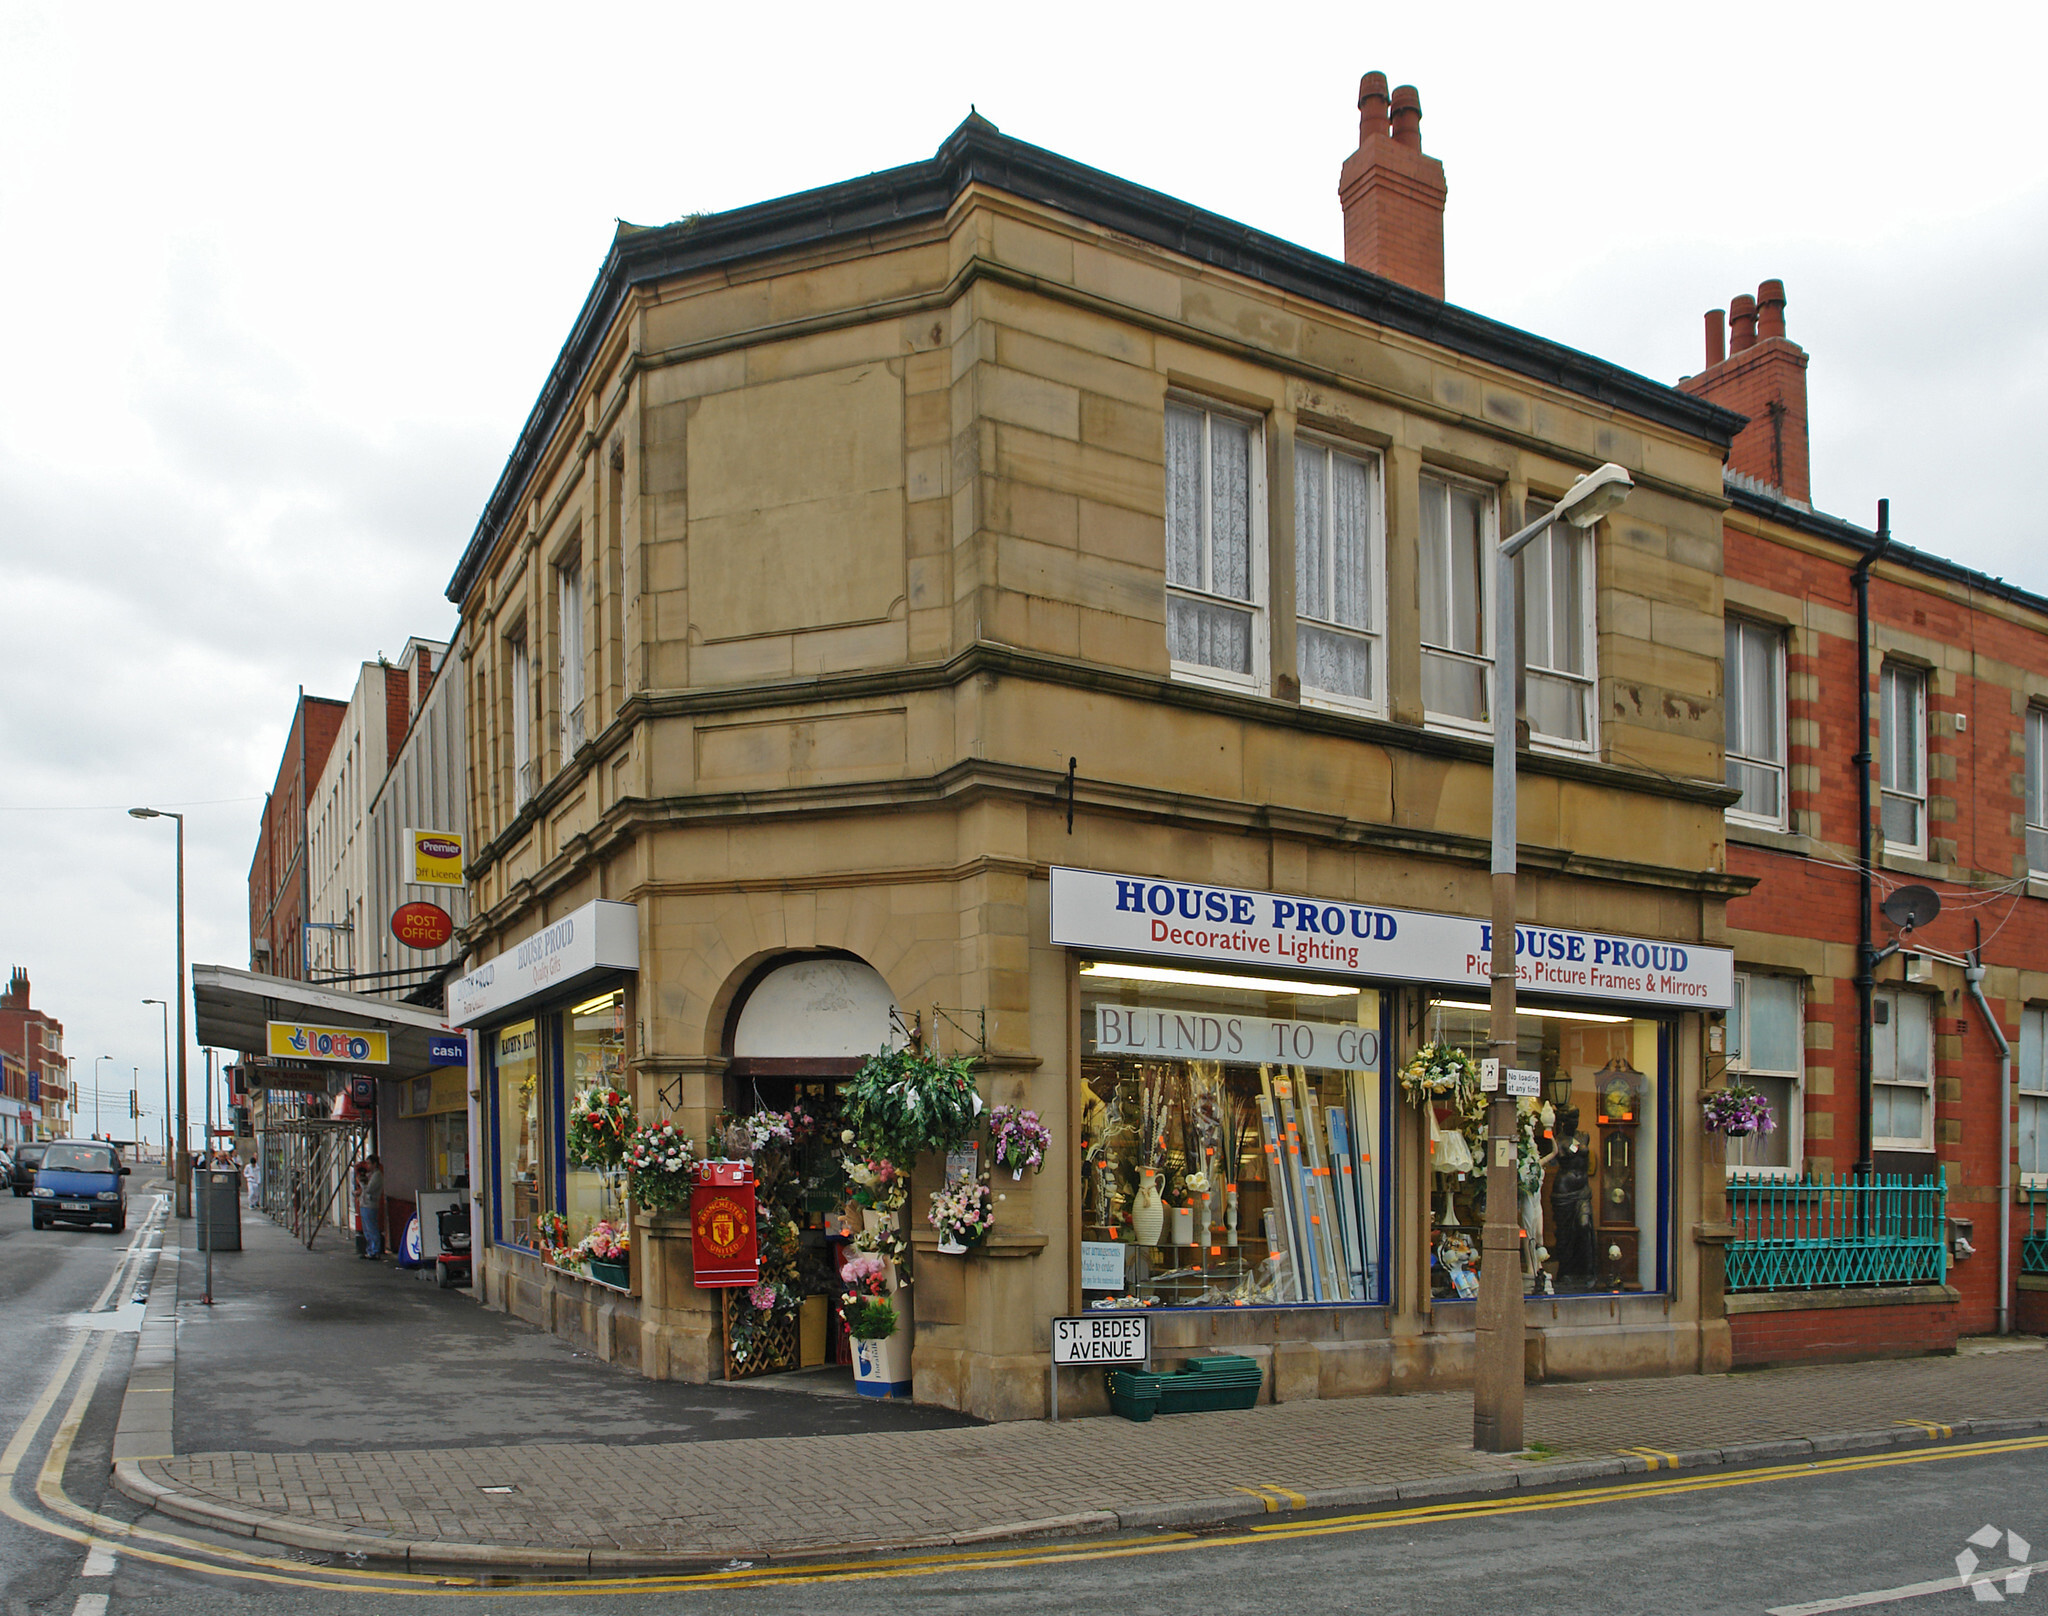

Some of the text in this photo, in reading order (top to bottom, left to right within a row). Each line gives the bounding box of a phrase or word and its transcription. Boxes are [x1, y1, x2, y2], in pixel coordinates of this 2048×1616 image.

[423, 841, 460, 854] Premier
[406, 914, 438, 927] POST
[1114, 880, 1399, 942] HOUSE PROUD
[402, 926, 443, 941] OFFICE
[517, 918, 575, 970] HOUSE PROUD
[1150, 919, 1361, 969] Decorative Lighting
[1593, 938, 1689, 973] PROUD
[1535, 962, 1587, 985] Picture
[1590, 967, 1642, 991] Frames
[1646, 973, 1656, 992] &
[1660, 975, 1708, 997] Mirrors
[308, 1031, 370, 1060] Lotto
[501, 1033, 521, 1055] KATHY'S
[1100, 1008, 1380, 1066] BLINDS TO GO
[432, 1045, 463, 1057] cash
[1508, 1072, 1539, 1084] No loading
[1515, 1086, 1526, 1094] any
[1527, 1084, 1540, 1093] time
[1499, 1147, 1506, 1157] 7
[701, 1201, 745, 1221] MANCHESTER
[709, 1243, 739, 1254] UNITED
[1059, 1320, 1141, 1339] ST. BEDES
[1069, 1340, 1133, 1359] AVENUE
